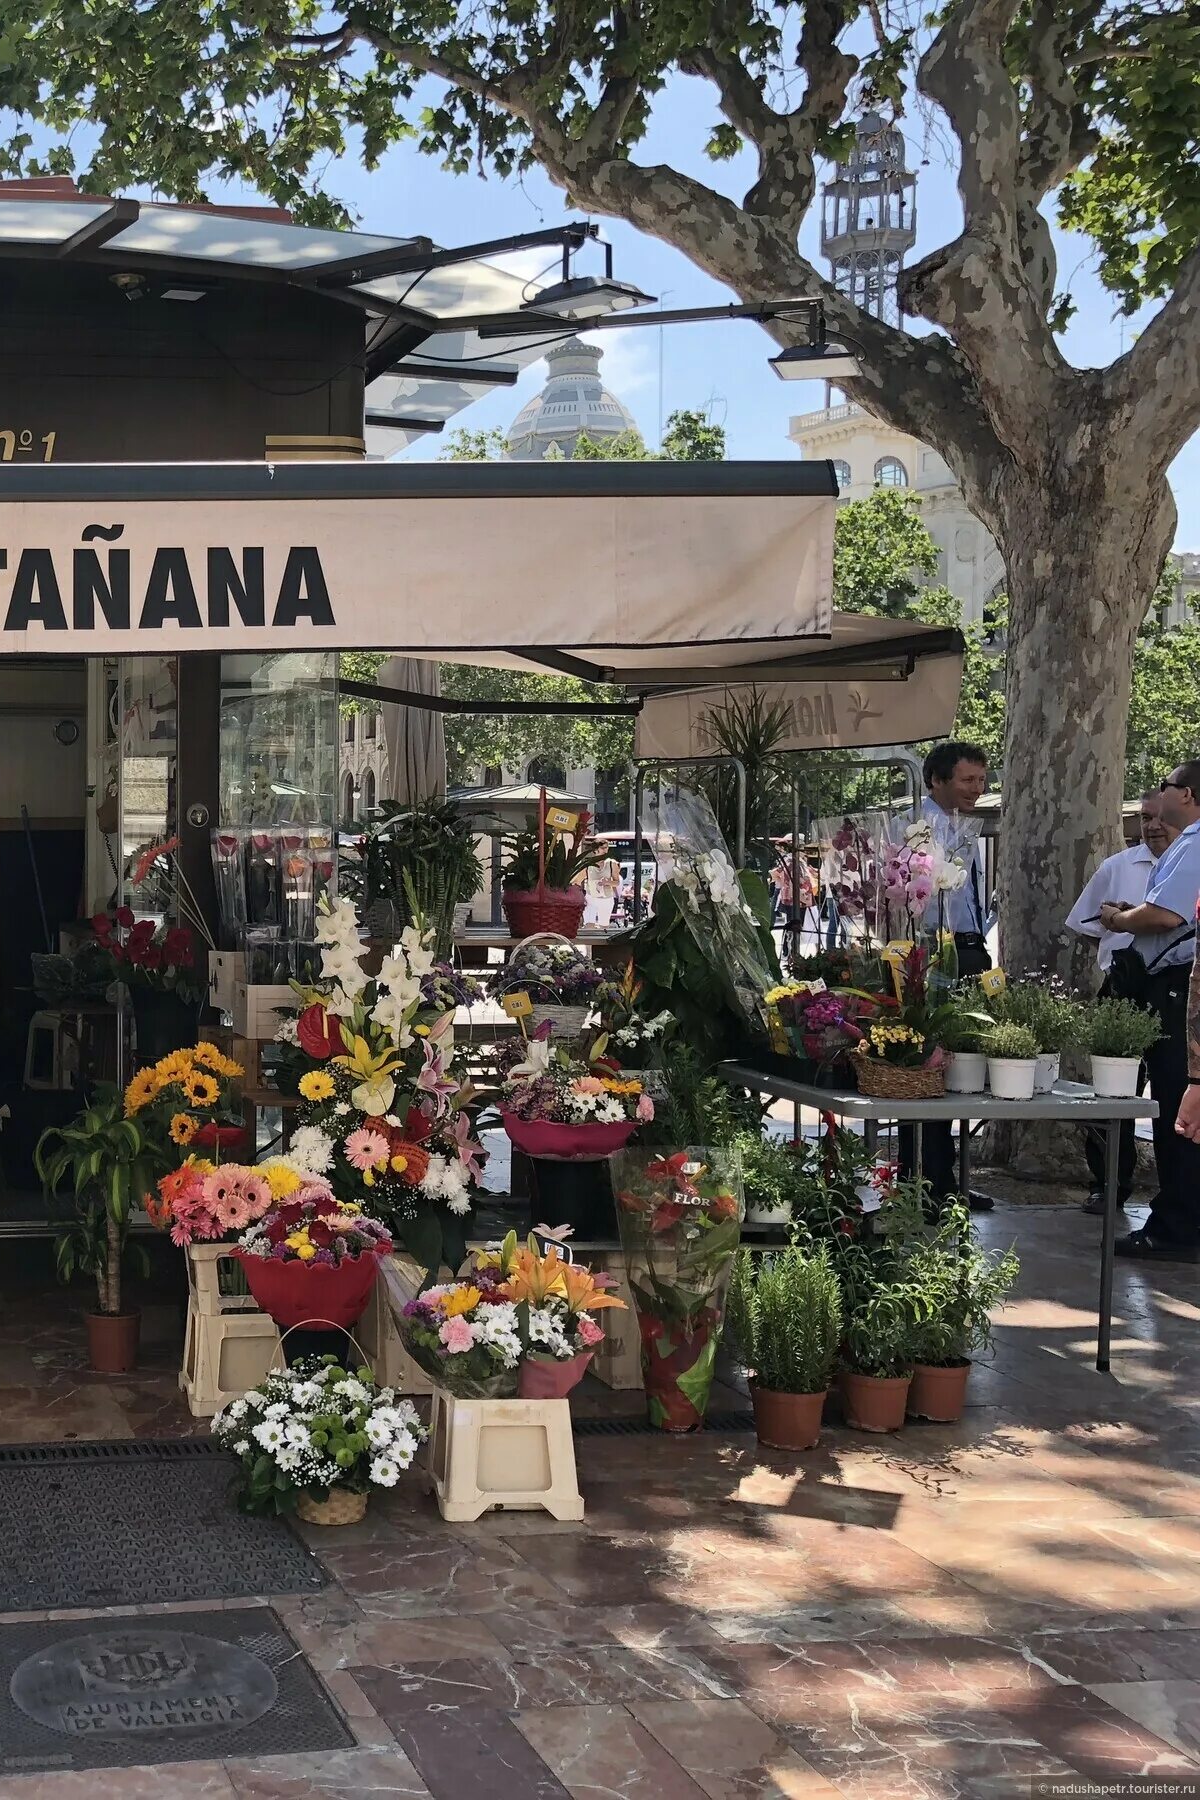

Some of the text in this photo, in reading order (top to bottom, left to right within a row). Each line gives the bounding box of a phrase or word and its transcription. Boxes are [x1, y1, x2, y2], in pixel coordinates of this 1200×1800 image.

[674, 1192, 711, 1206] FLOR
[66, 1695, 239, 1717] AJUNTAMENT
[75, 1709, 244, 1730] DE VALENCIA
